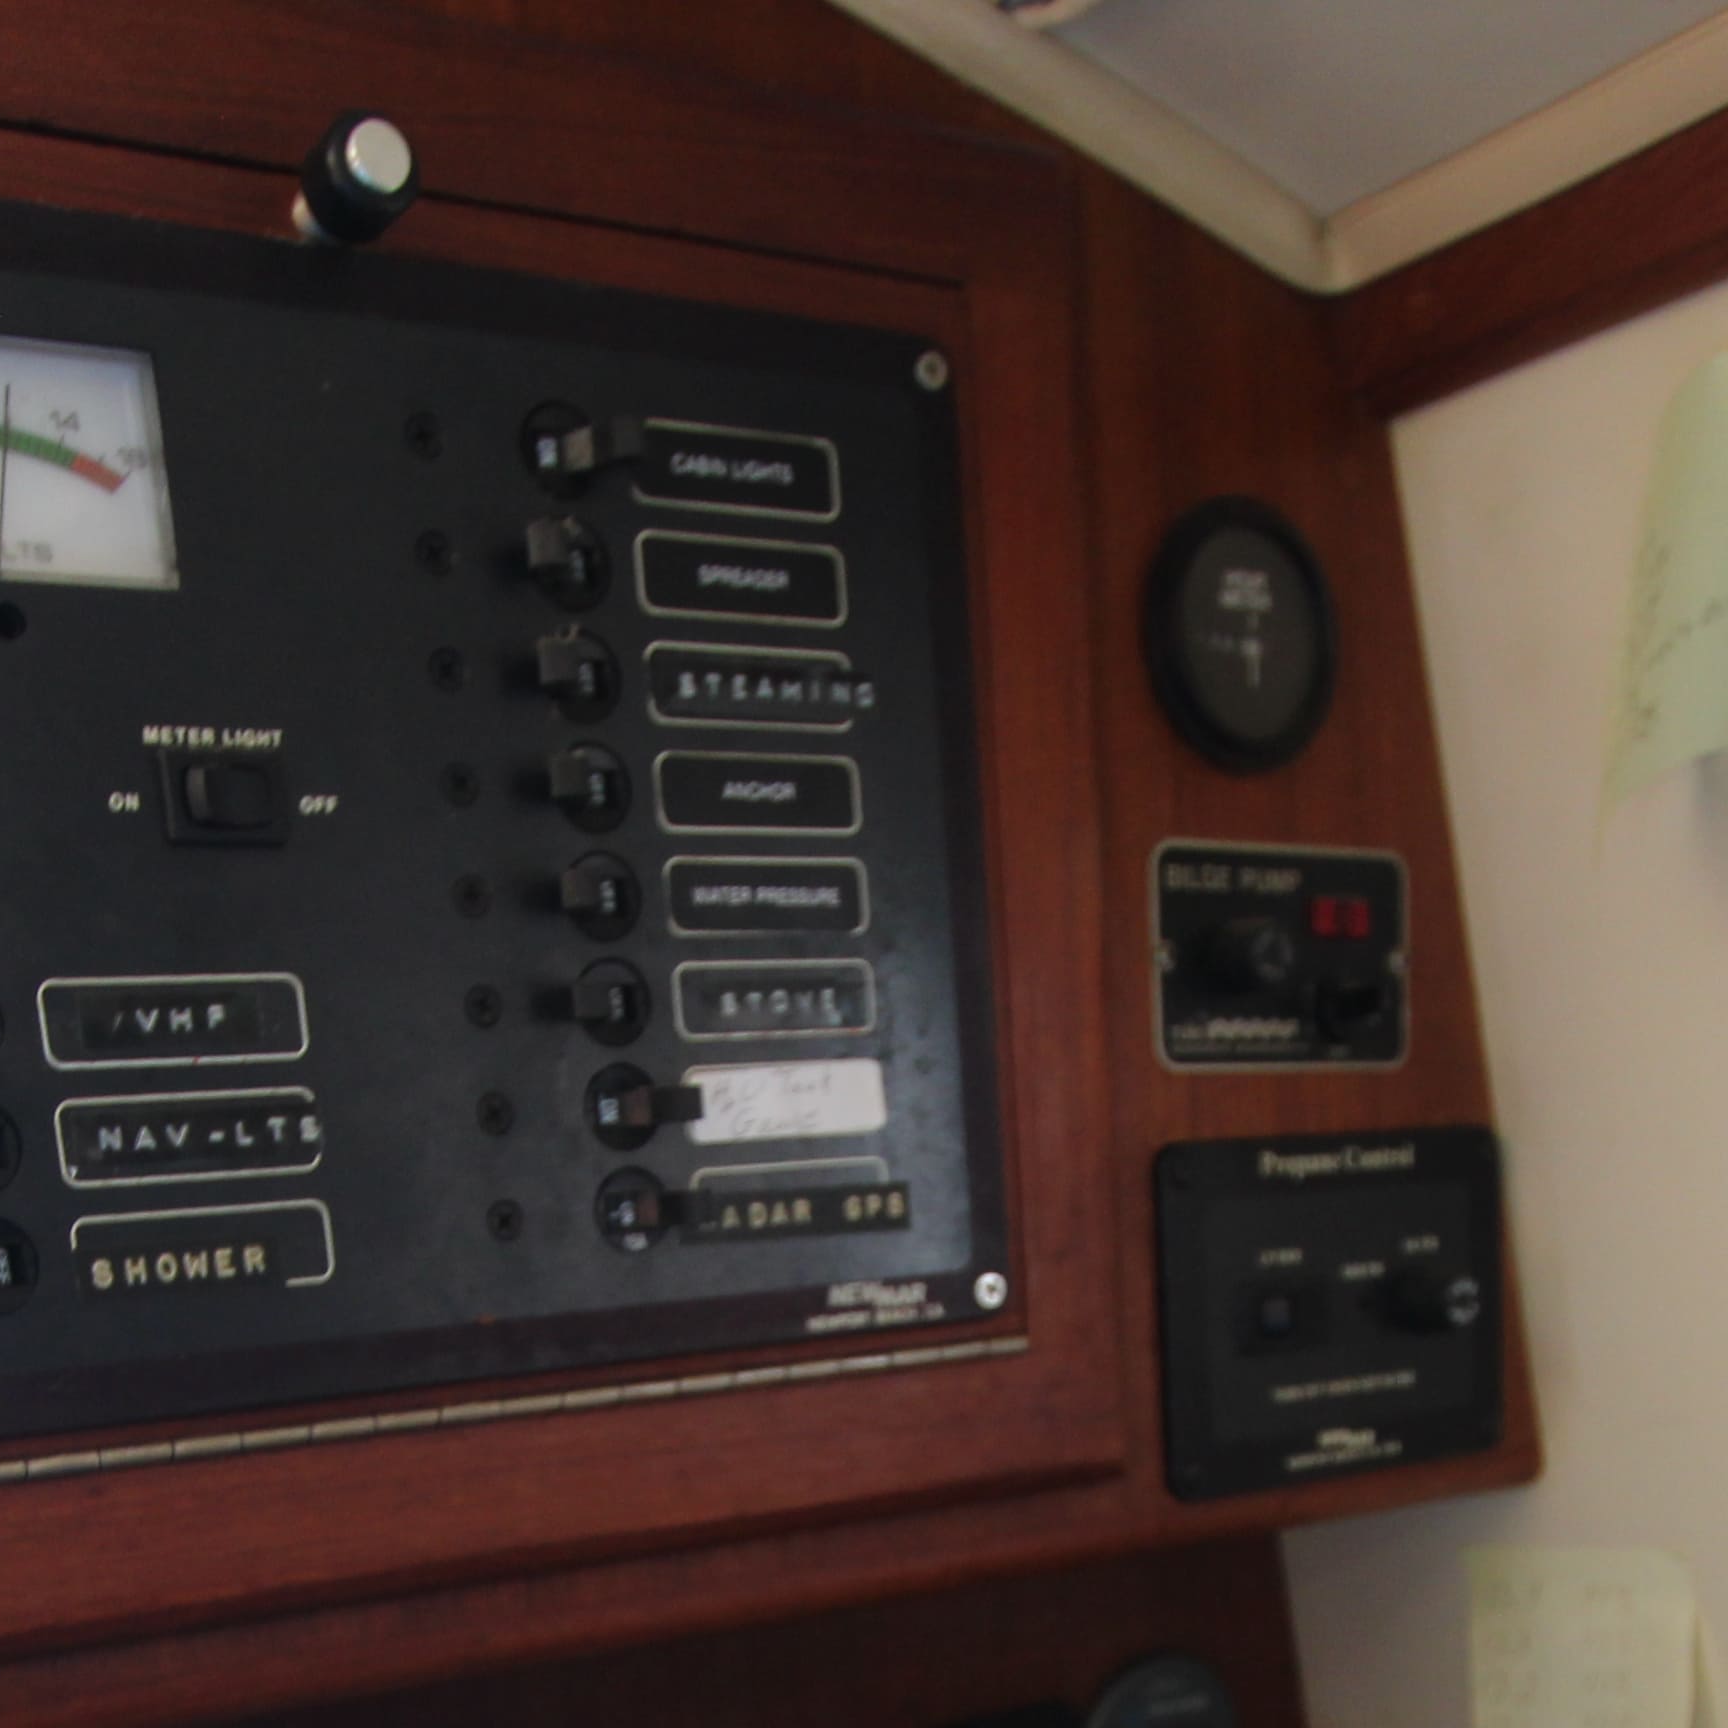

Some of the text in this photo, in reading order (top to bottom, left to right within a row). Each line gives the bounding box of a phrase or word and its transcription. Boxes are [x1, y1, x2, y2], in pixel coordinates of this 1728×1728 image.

[678, 672, 874, 708] STEAMING
[142, 725, 282, 748] METER LIGHT
[108, 791, 140, 812] ON
[721, 780, 797, 802] ANCHOR
[298, 794, 338, 815] OFF
[693, 885, 840, 907] WATER PRESSURE
[98, 1115, 324, 1150] NAV-LTS
[699, 1191, 905, 1231] ADAR GPS
[91, 1243, 267, 1290] SHOWER
